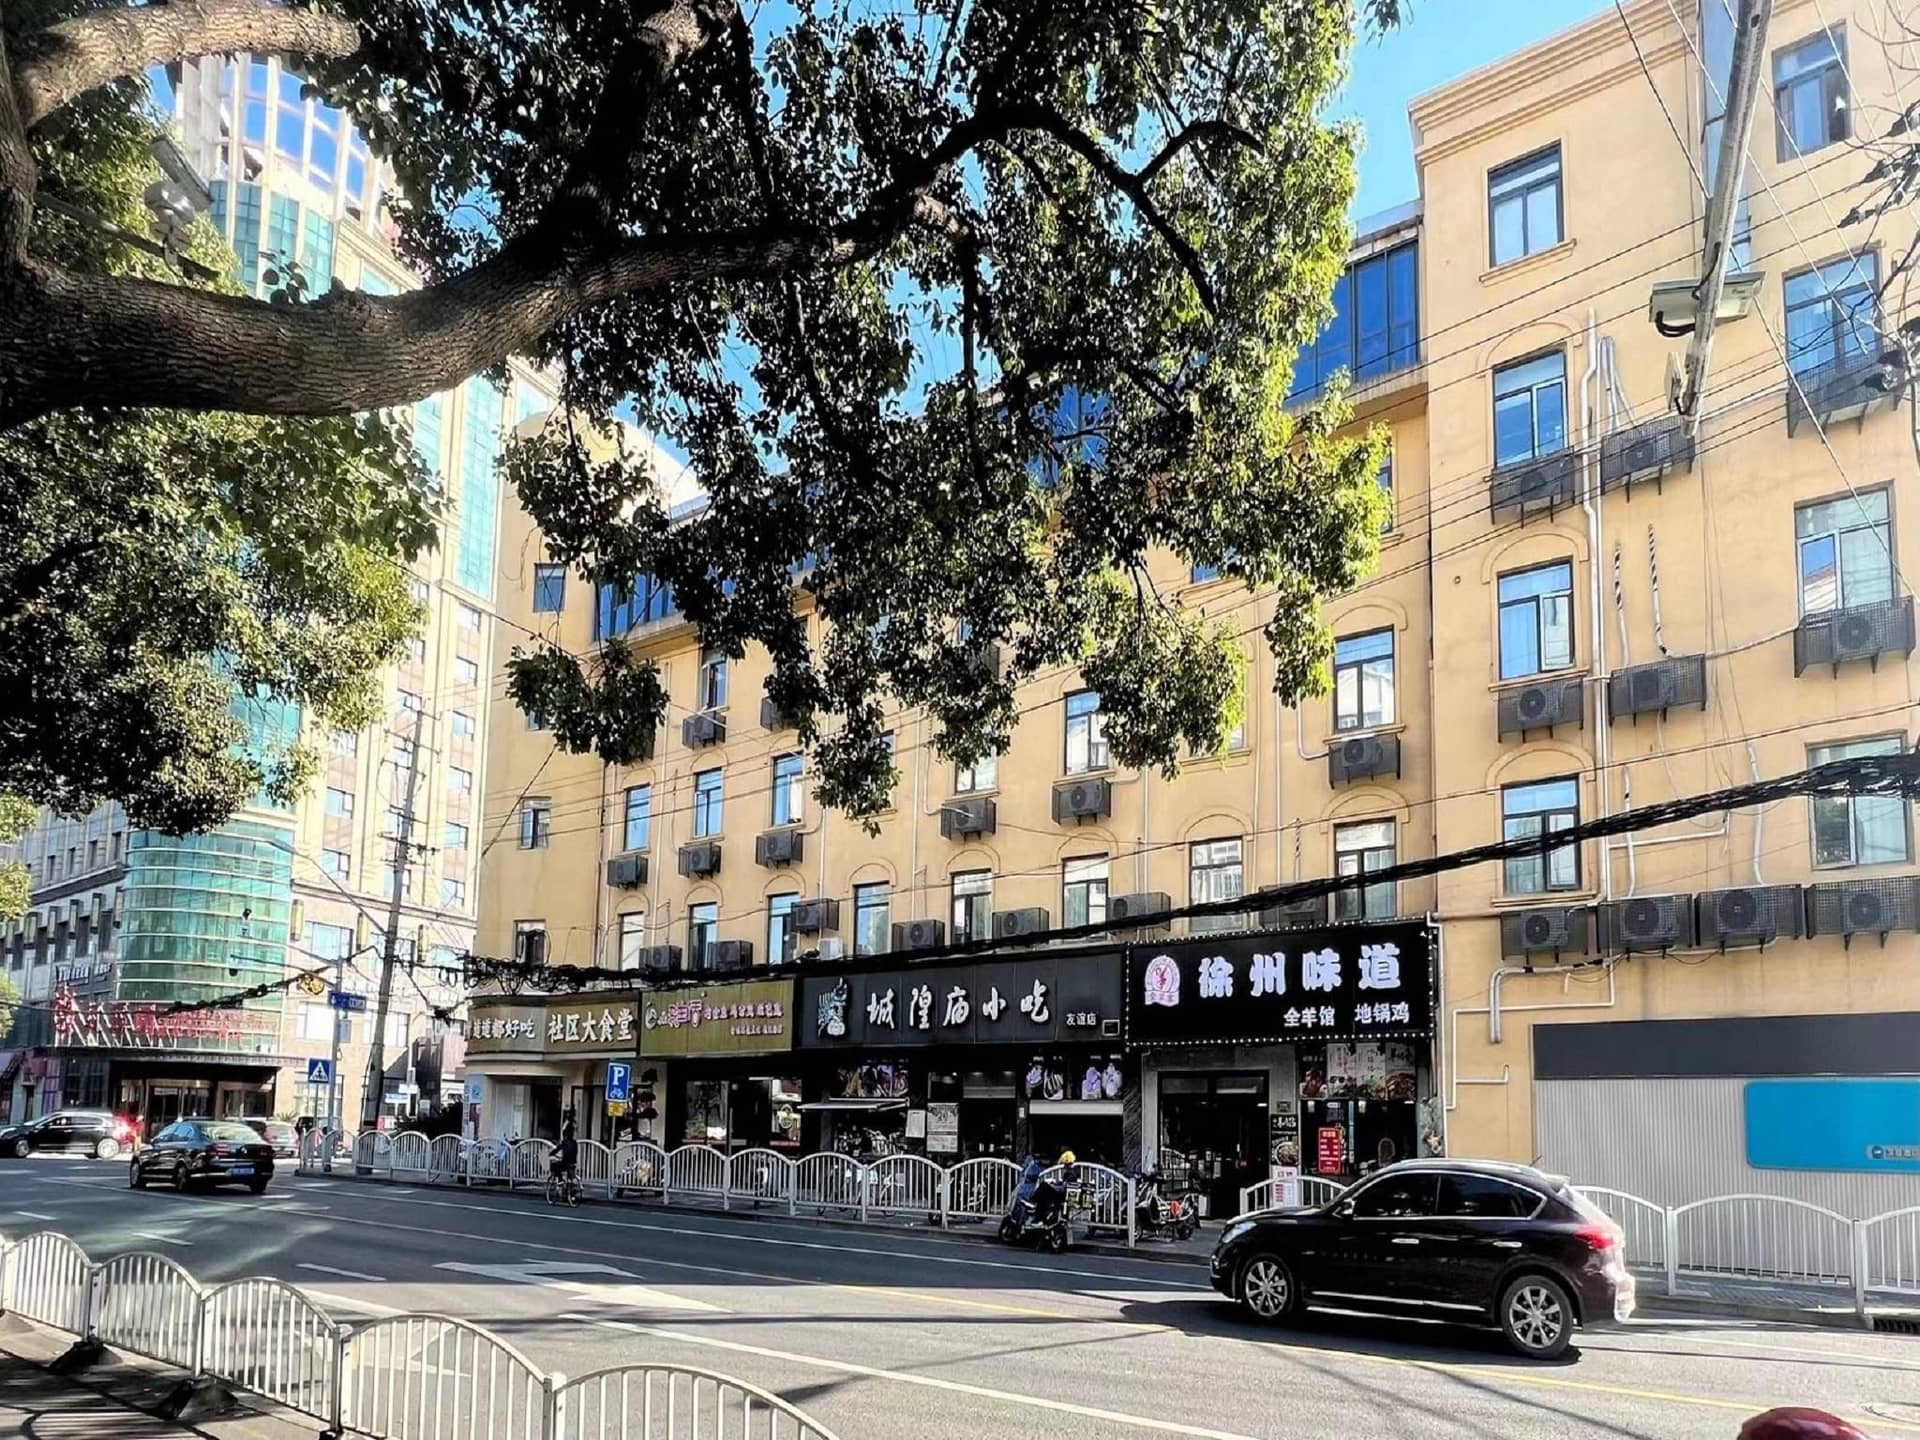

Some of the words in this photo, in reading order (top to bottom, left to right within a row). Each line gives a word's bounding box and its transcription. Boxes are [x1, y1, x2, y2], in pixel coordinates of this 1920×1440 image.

[1199, 943, 1401, 998] 徐州味道
[867, 978, 1049, 1029] 城隍庙小吃
[1066, 1012, 1096, 1025] 友谊店
[1284, 1005, 1335, 1027] 全羊馆
[1355, 1002, 1410, 1024] 地锅鸡
[549, 1008, 633, 1043] 社区大食堂
[613, 1067, 624, 1086] P
